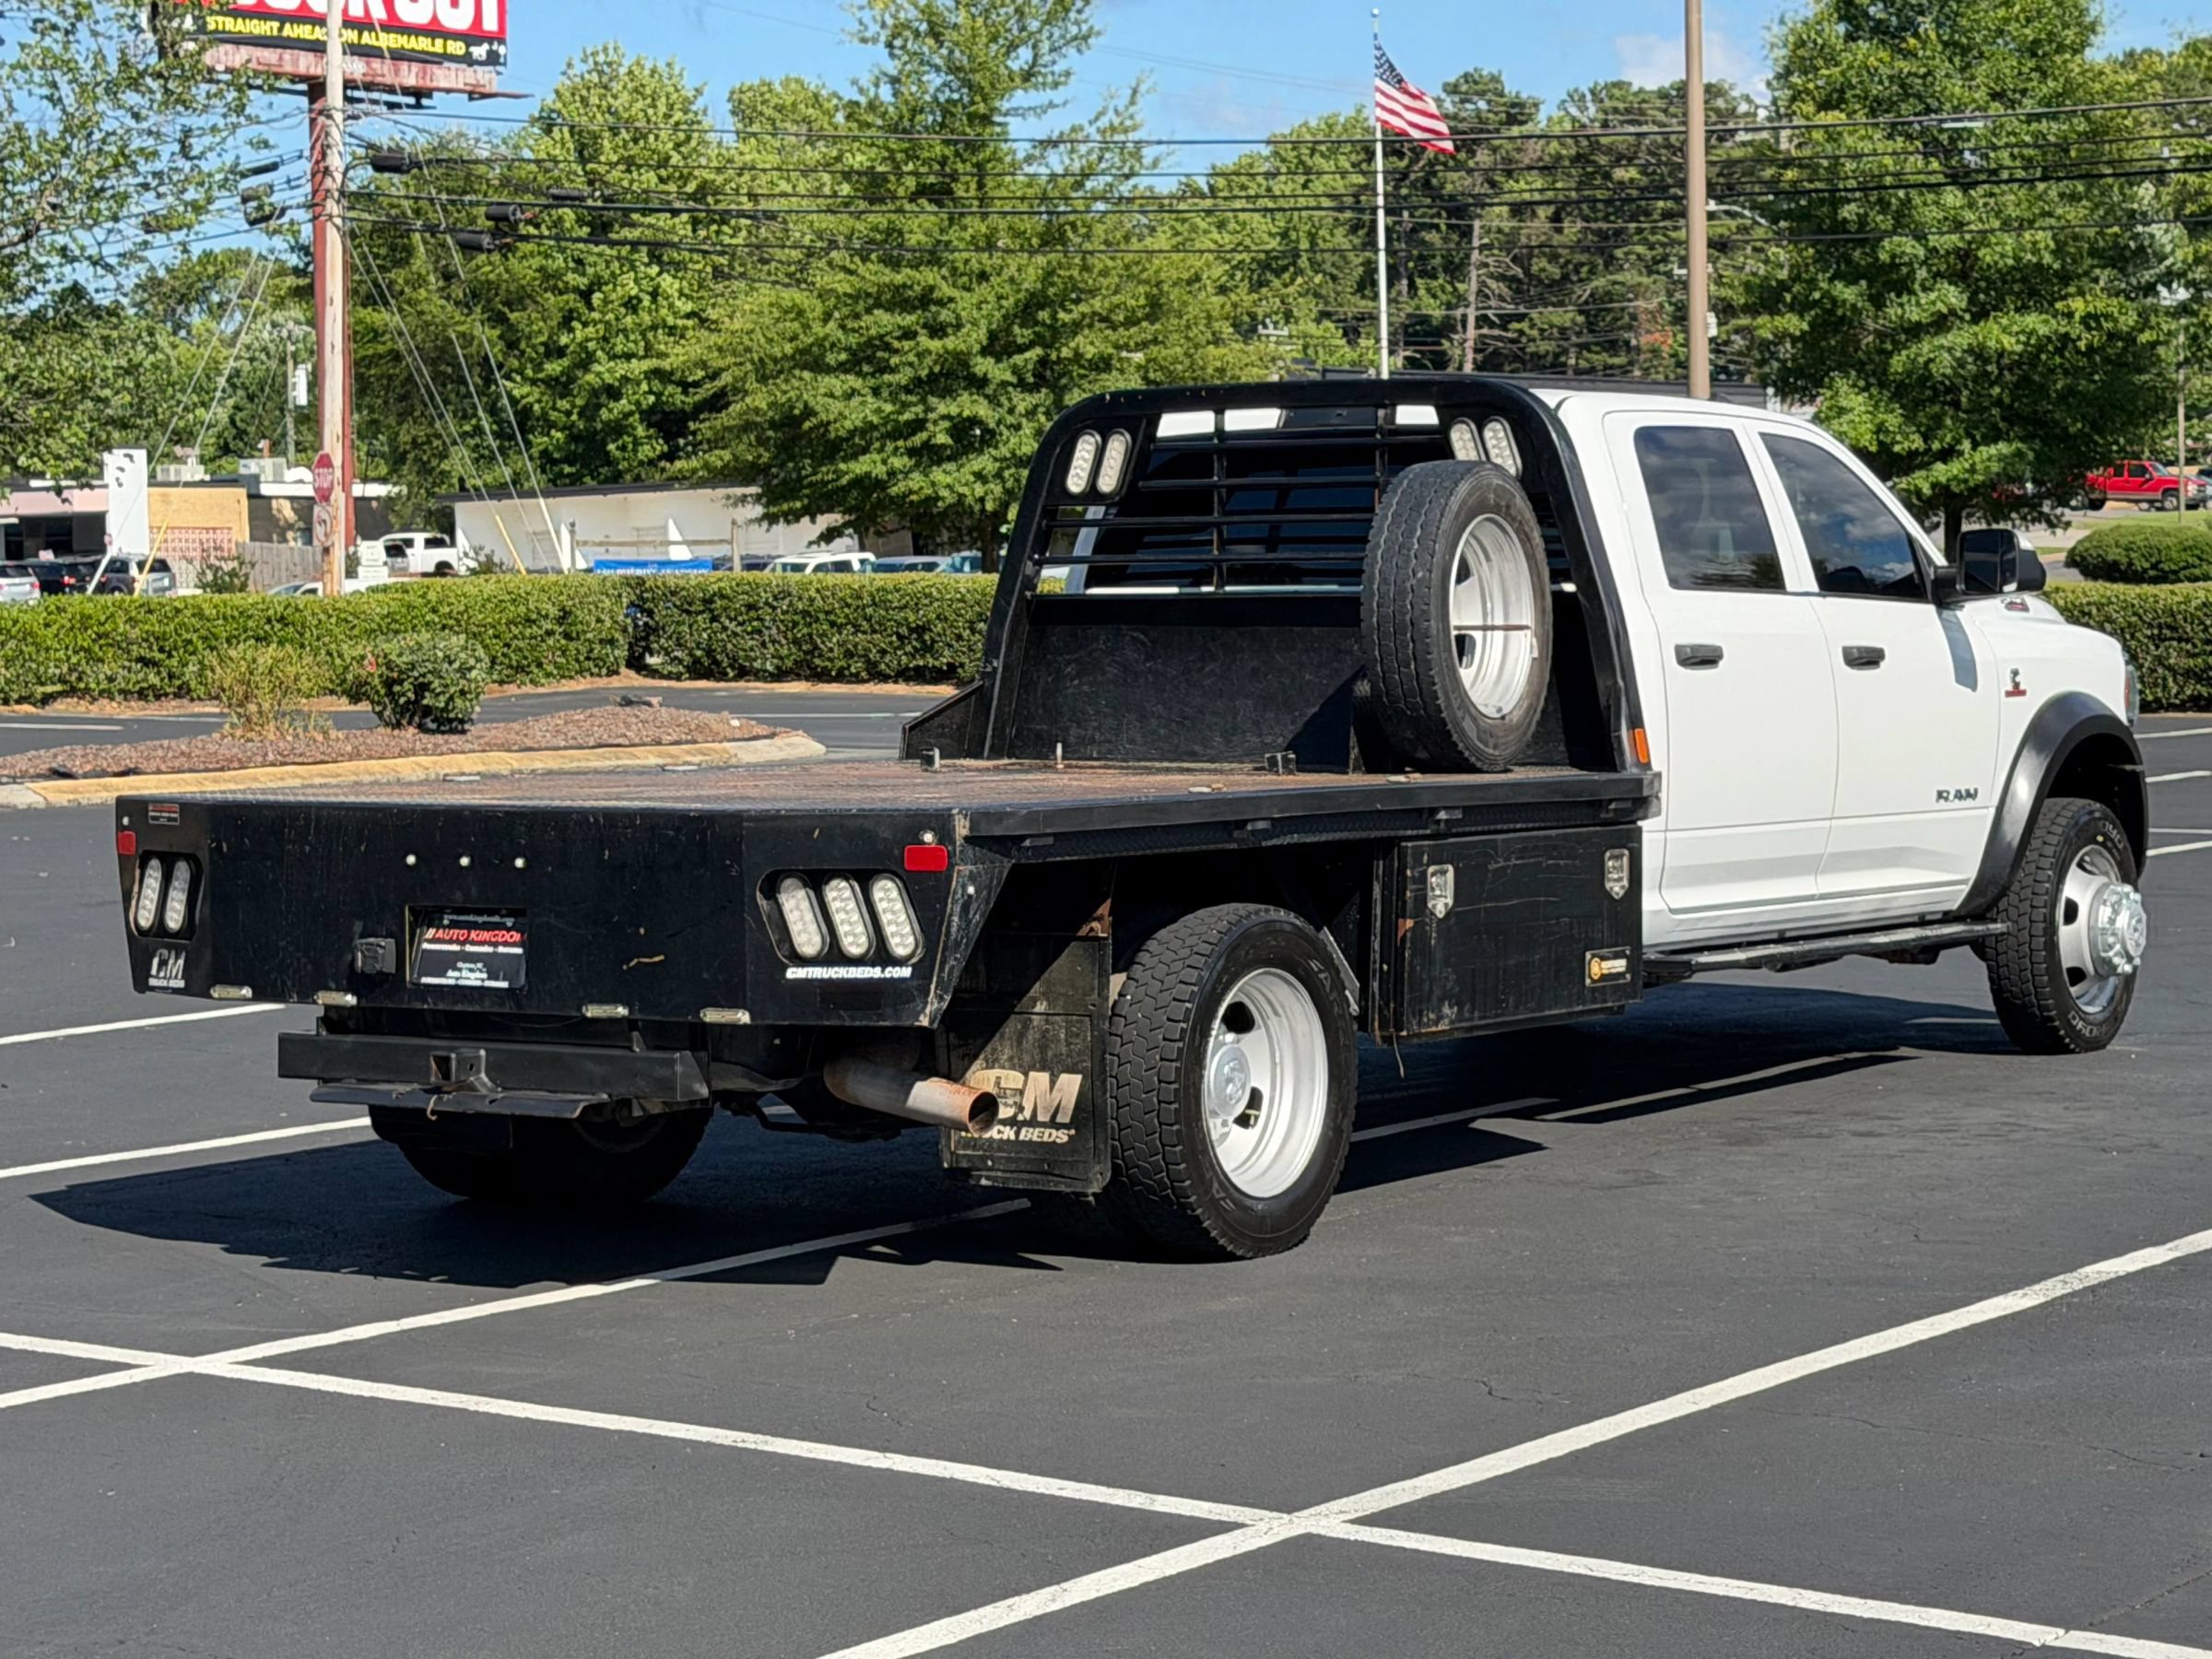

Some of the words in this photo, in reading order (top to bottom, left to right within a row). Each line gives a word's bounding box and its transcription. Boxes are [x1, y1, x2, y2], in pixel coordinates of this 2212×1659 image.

[206, 16, 280, 36] STRAIGHT
[446, 39, 466, 56] RD
[314, 467, 333, 488] STOP
[1936, 787, 1979, 803] RAM
[434, 927, 468, 941] AUTO
[786, 966, 912, 980] CMTRUCKBEDS.COM
